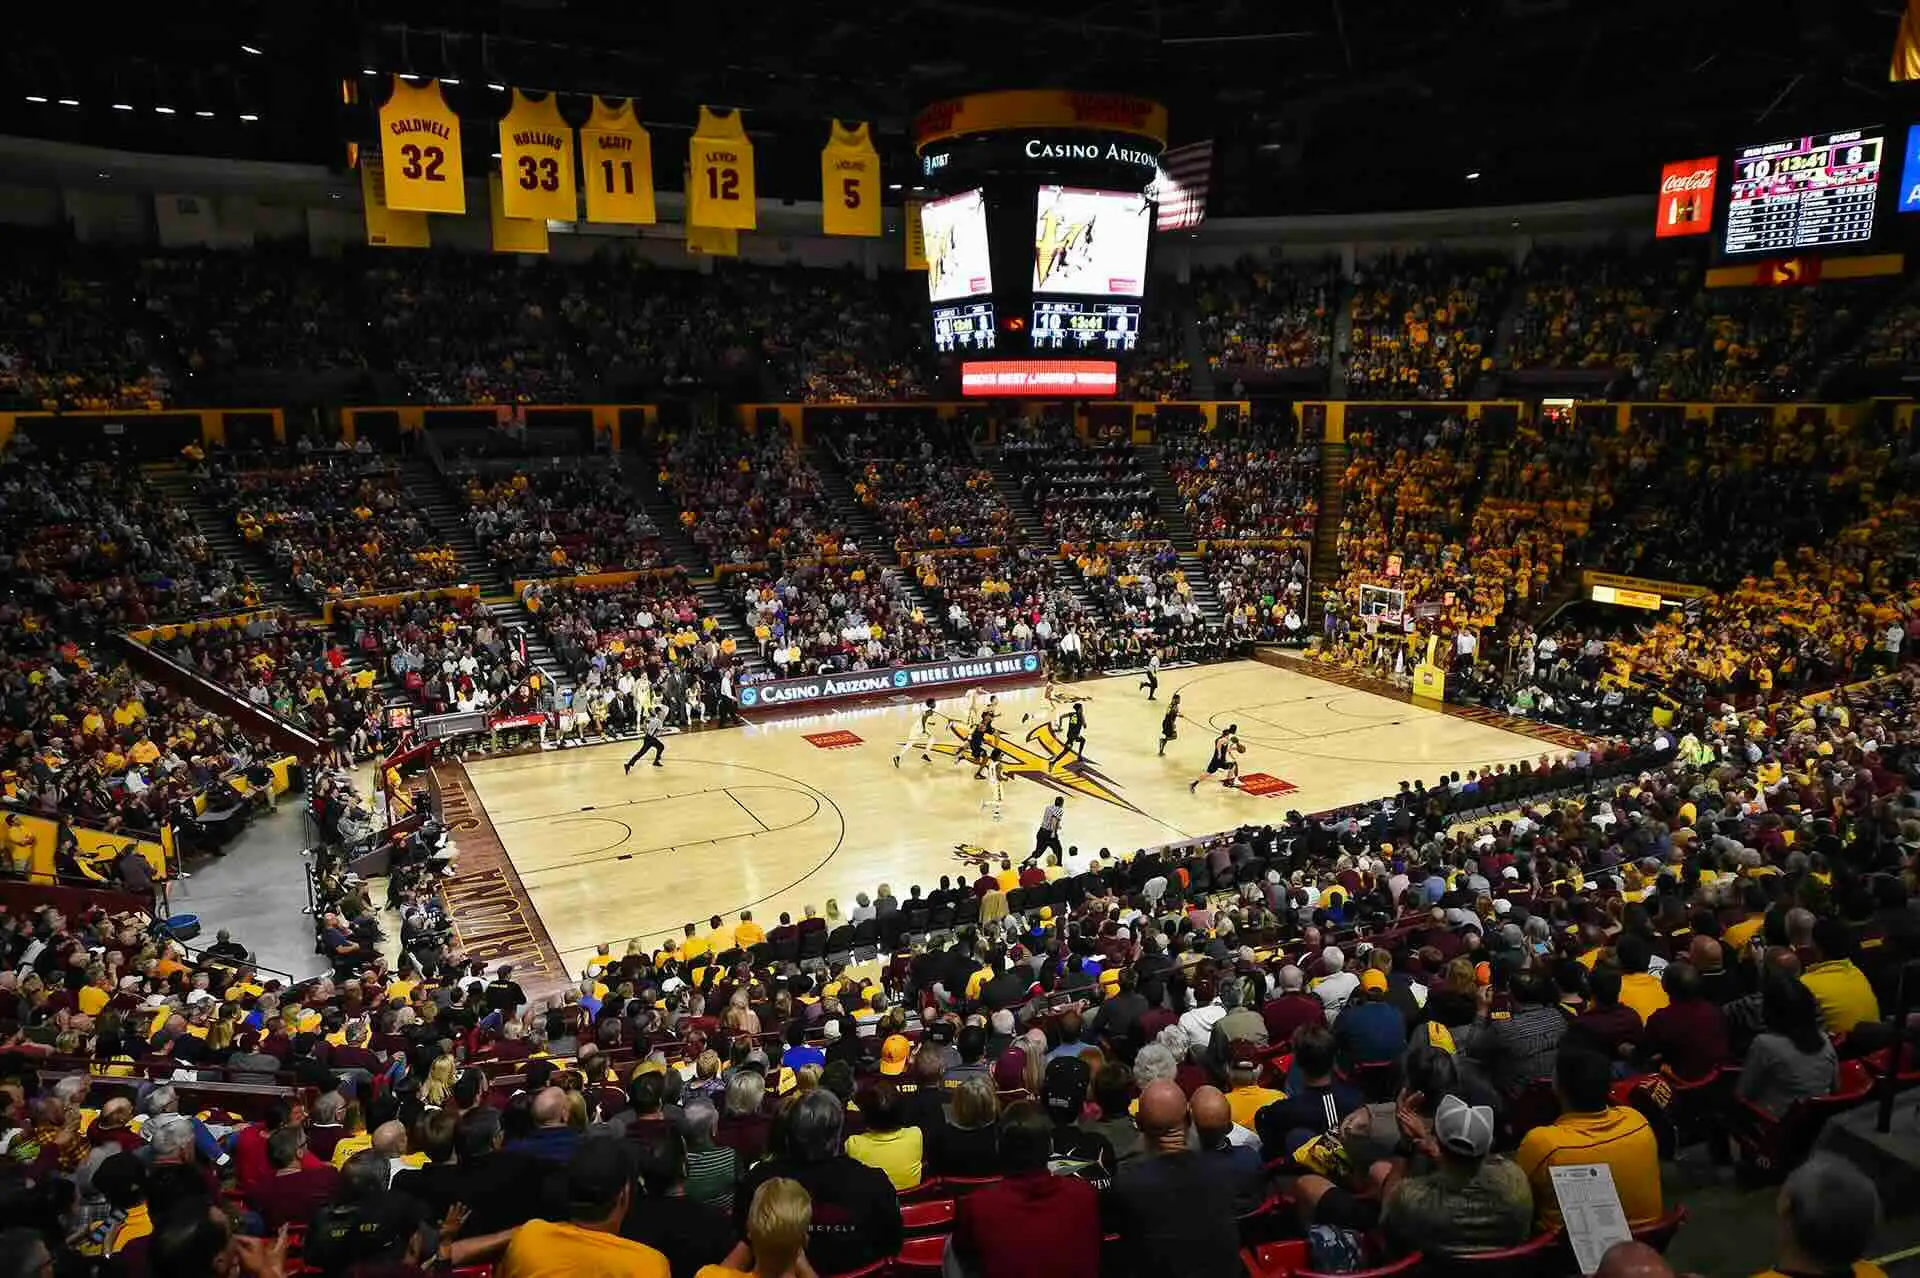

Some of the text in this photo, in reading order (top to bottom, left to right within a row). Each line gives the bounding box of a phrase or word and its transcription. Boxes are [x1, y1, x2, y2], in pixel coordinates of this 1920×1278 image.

[391, 118, 450, 140] CALDWELL
[513, 132, 562, 151] HOLLINS
[598, 135, 633, 151] SCOTT
[401, 144, 446, 182] 32
[931, 153, 950, 170] AT&T
[1025, 139, 1159, 168] CASINO ARIZONA
[518, 156, 559, 192] 33
[600, 160, 635, 195] 11
[706, 167, 740, 201] 12
[1663, 168, 1717, 194] Coca-Cola
[1744, 160, 1770, 180] 10
[843, 178, 862, 210] 5
[760, 658, 1022, 703] CASINO ARIZONA WHERE LOCALS RULE
